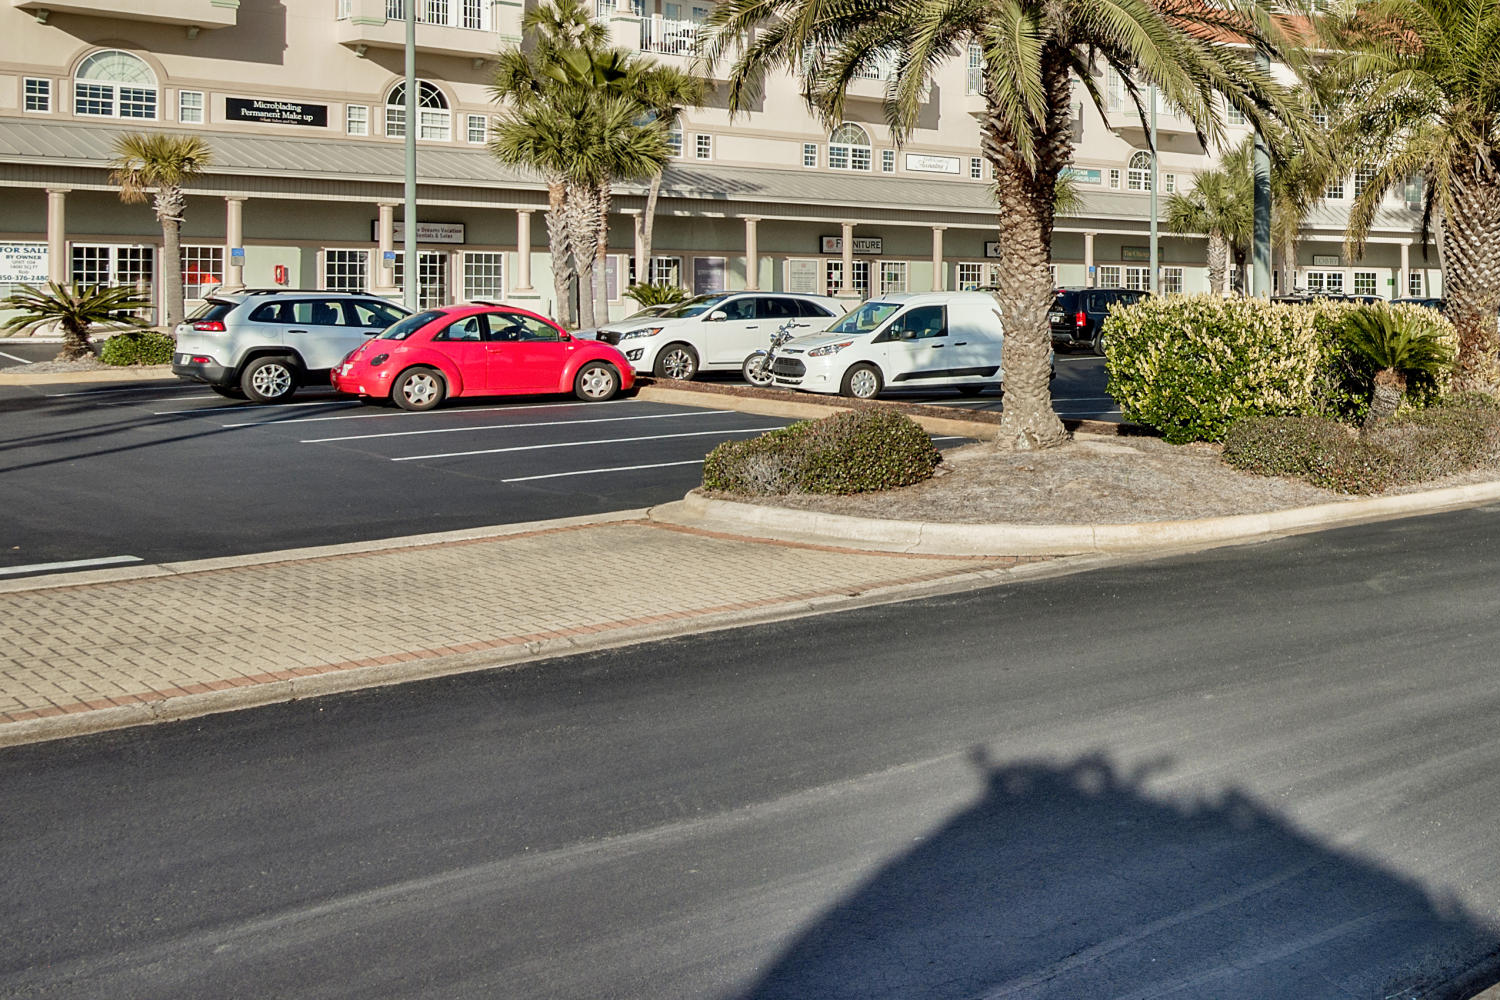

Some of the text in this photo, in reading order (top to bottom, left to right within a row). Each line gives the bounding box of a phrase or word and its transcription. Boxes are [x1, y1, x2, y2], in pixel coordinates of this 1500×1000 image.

[253, 100, 302, 112] Microblading
[241, 108, 281, 119] Permanent
[282, 111, 302, 120] Make
[303, 114, 314, 122] up
